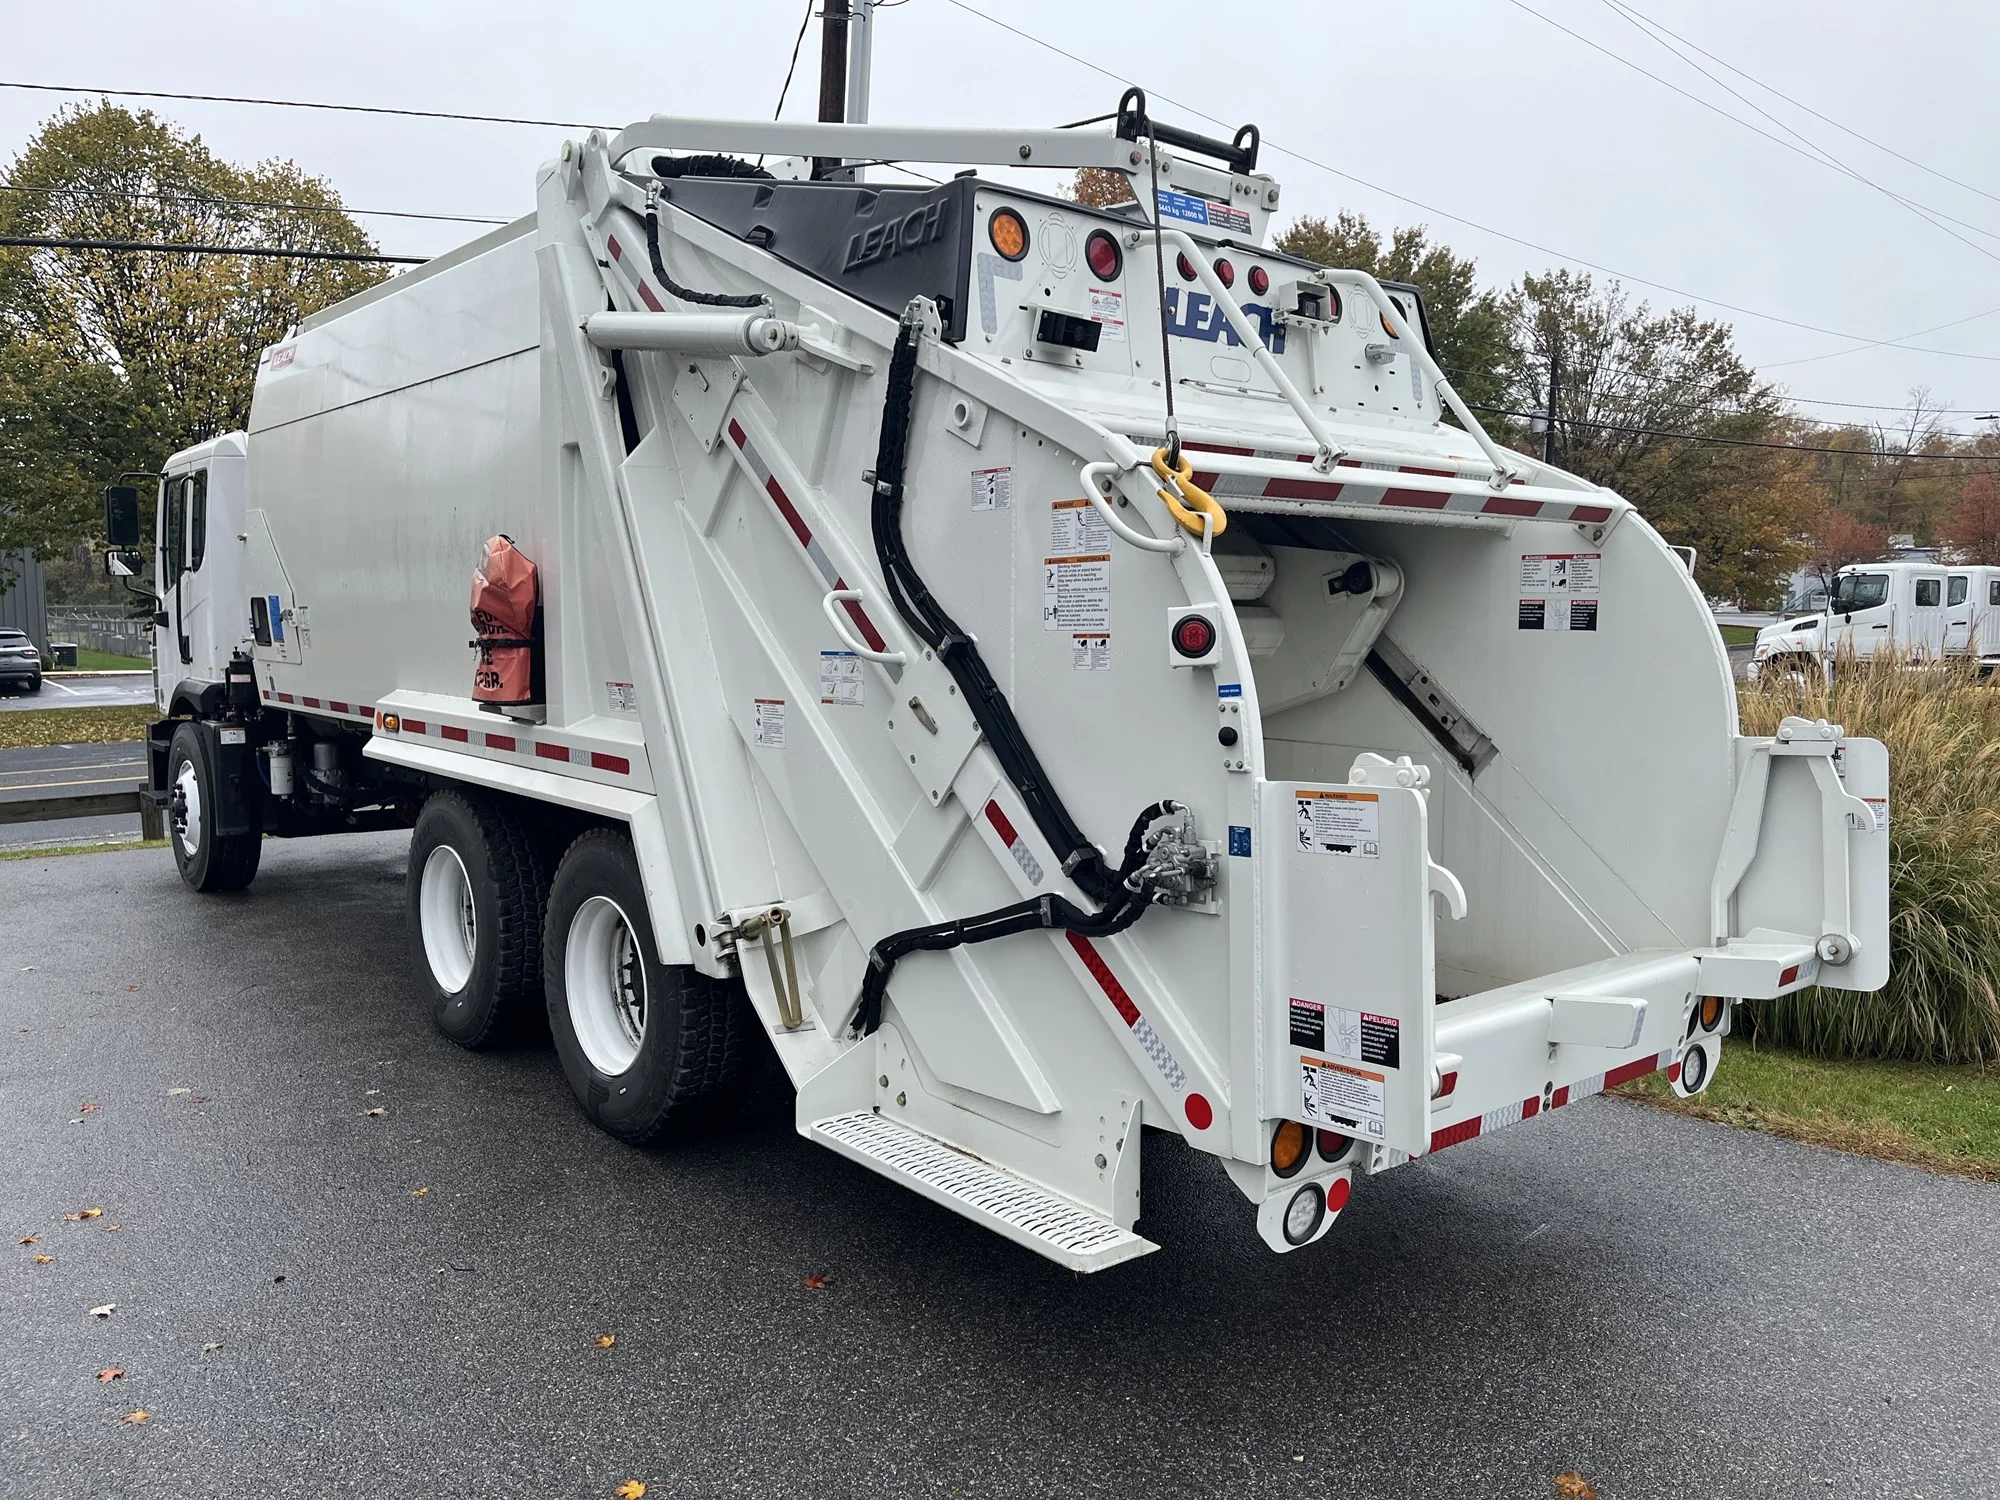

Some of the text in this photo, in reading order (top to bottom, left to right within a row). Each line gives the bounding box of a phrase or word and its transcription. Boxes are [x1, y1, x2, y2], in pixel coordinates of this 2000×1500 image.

[1172, 207, 1179, 216] kg
[1182, 209, 1197, 219] 12000
[1198, 212, 1204, 220] lb
[841, 198, 949, 275] LEACH
[273, 348, 294, 366] LEACH
[1296, 1000, 1322, 1011] DANGER
[1368, 1015, 1397, 1026] PELIGRO
[1327, 1063, 1362, 1076] ADVERTENCIA
